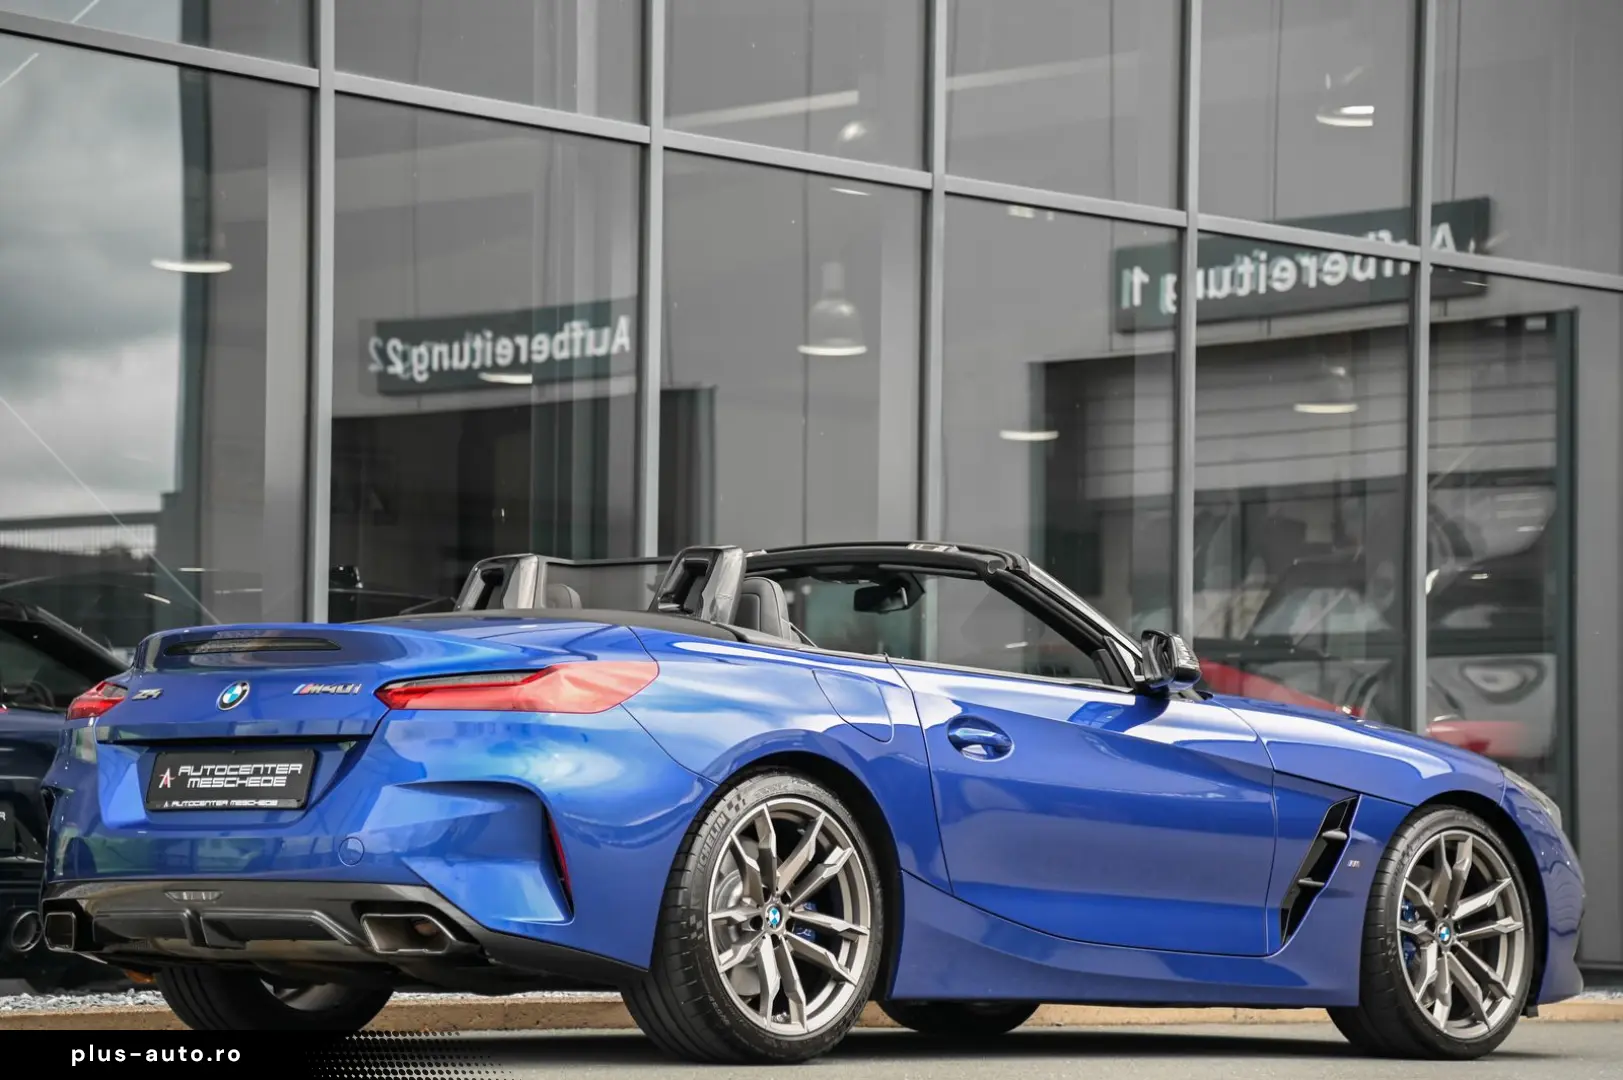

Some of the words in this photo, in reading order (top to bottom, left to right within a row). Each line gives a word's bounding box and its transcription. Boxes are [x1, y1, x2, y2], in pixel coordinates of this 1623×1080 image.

[131, 688, 163, 700] Z4
[178, 763, 303, 776] AUTOCENTER
[187, 776, 287, 788] MESCHEDE
